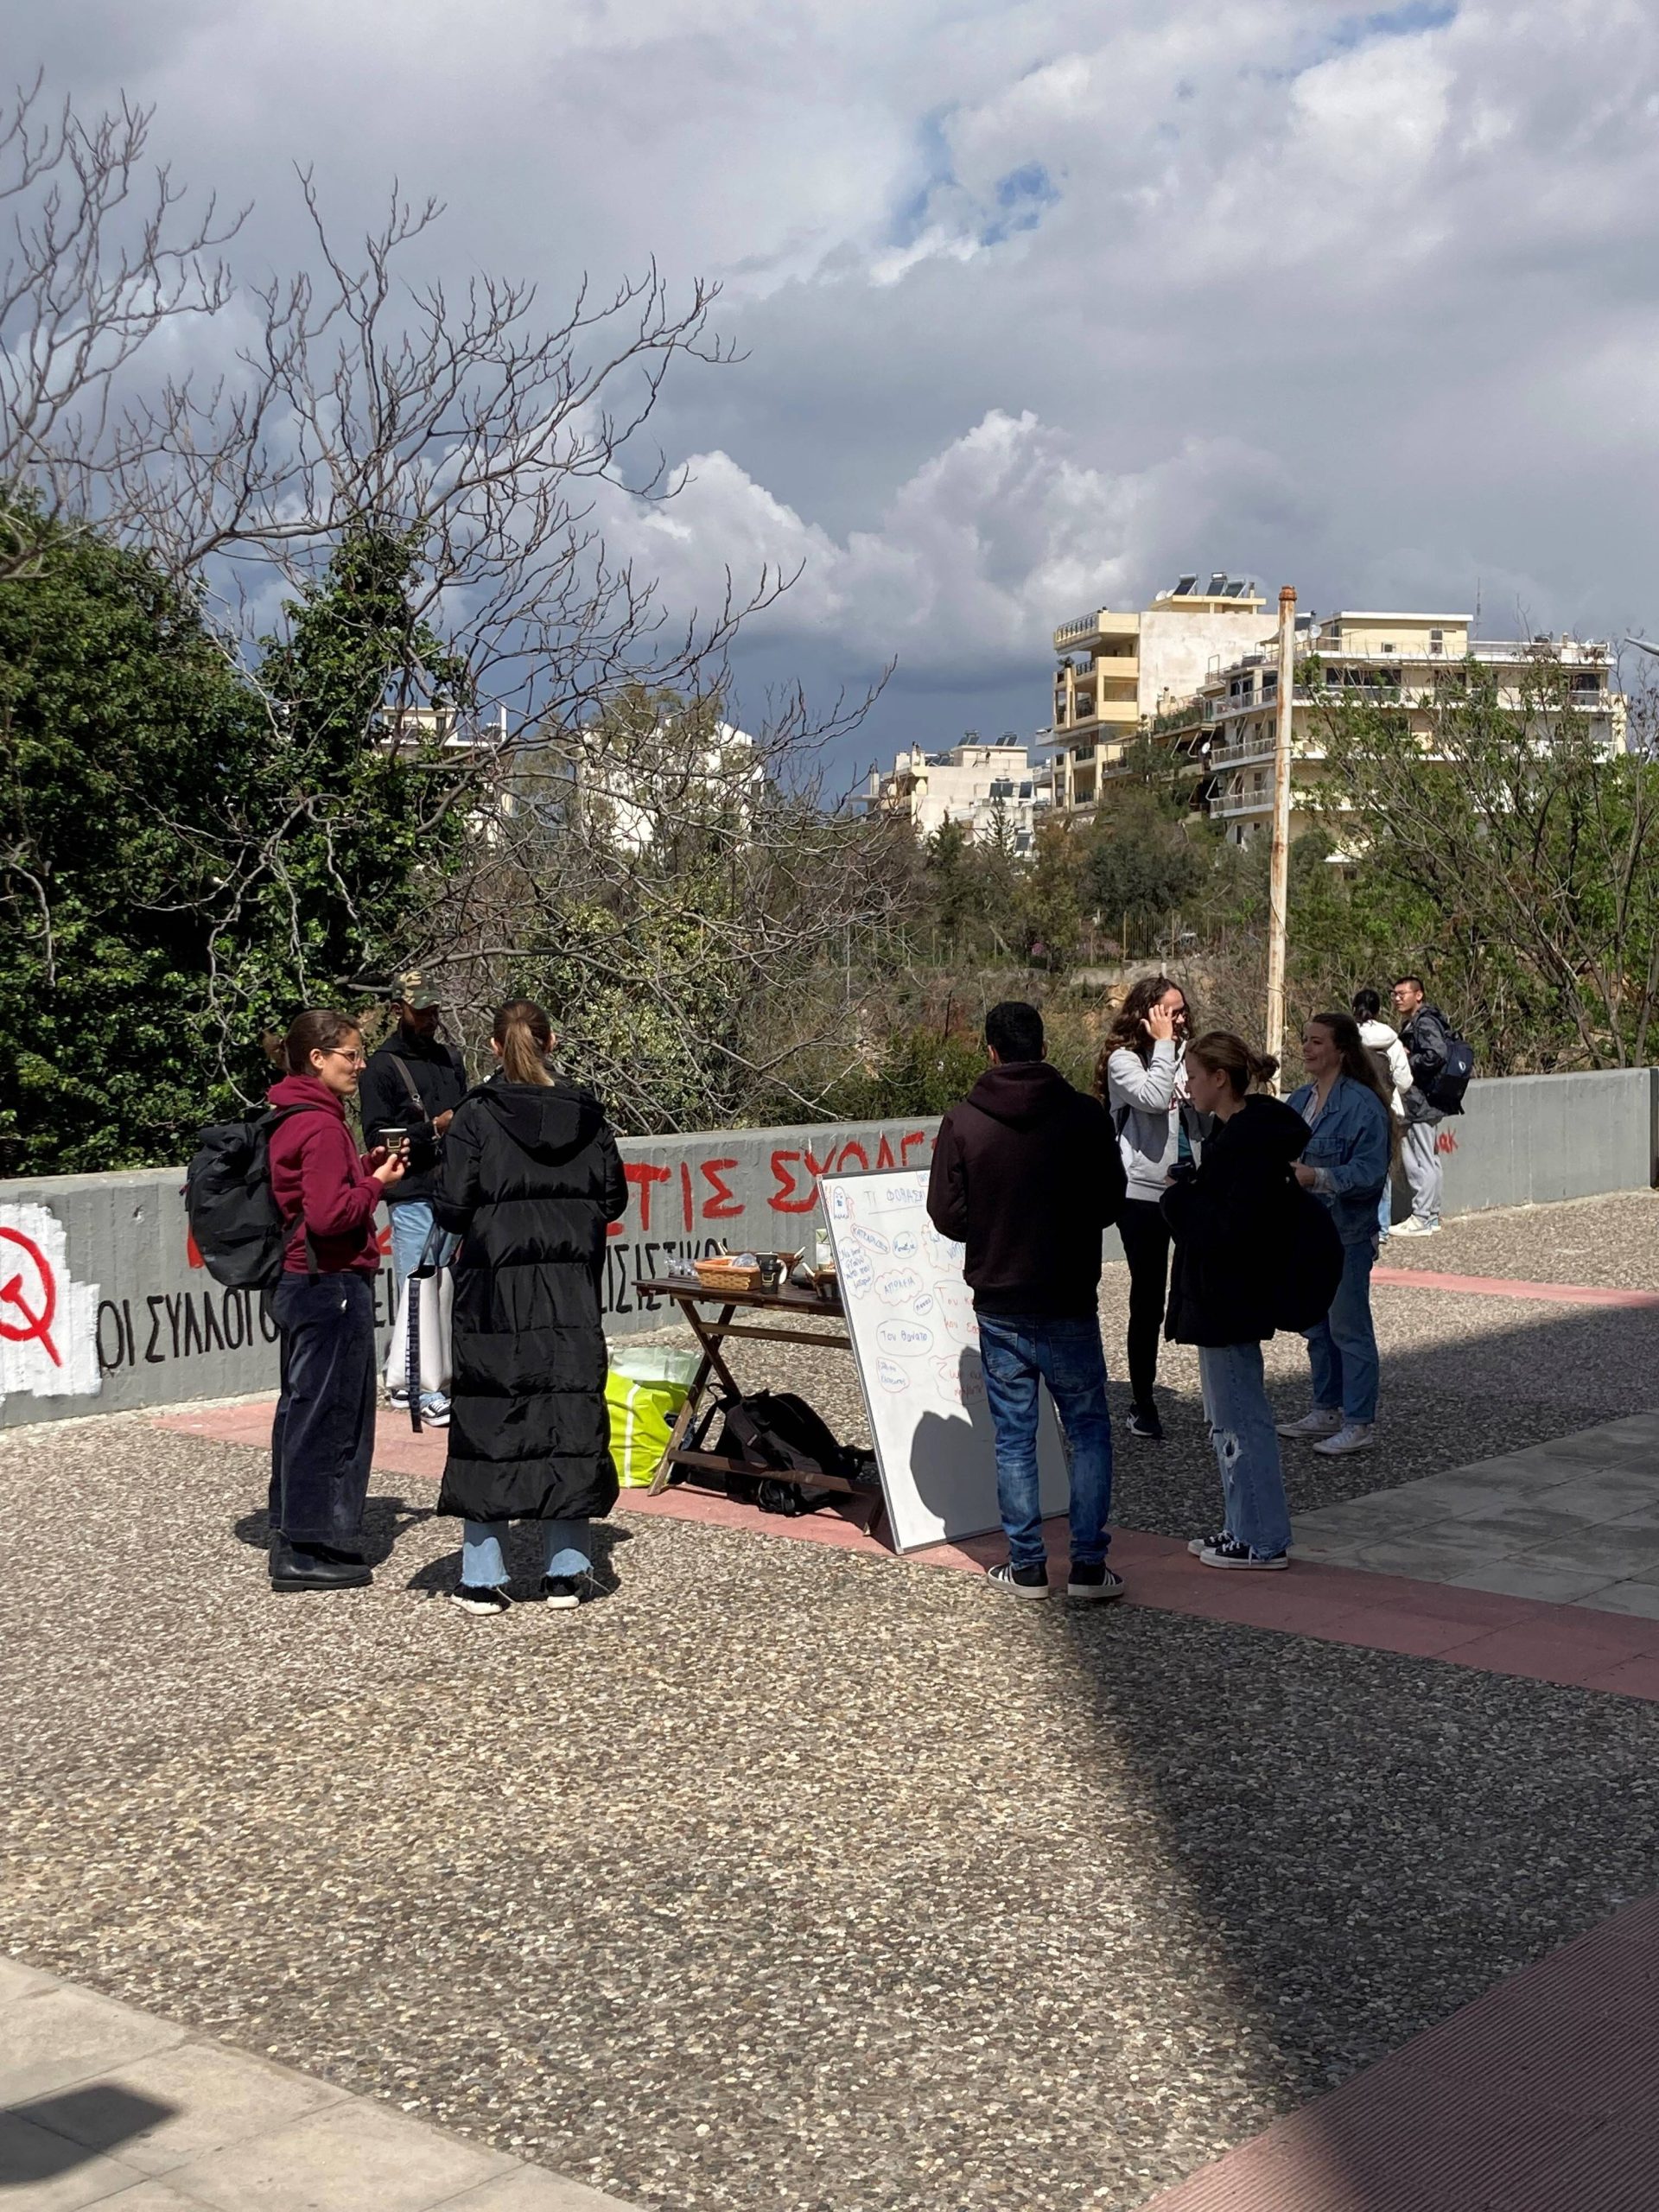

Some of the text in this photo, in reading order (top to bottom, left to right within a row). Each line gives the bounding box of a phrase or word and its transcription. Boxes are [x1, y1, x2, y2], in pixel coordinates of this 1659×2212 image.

[607, 1158, 746, 1236] ΤΙΣ
[96, 1299, 135, 1369] ΟΙ
[145, 1287, 281, 1363] ΣΥΛΛΟΓΟ
